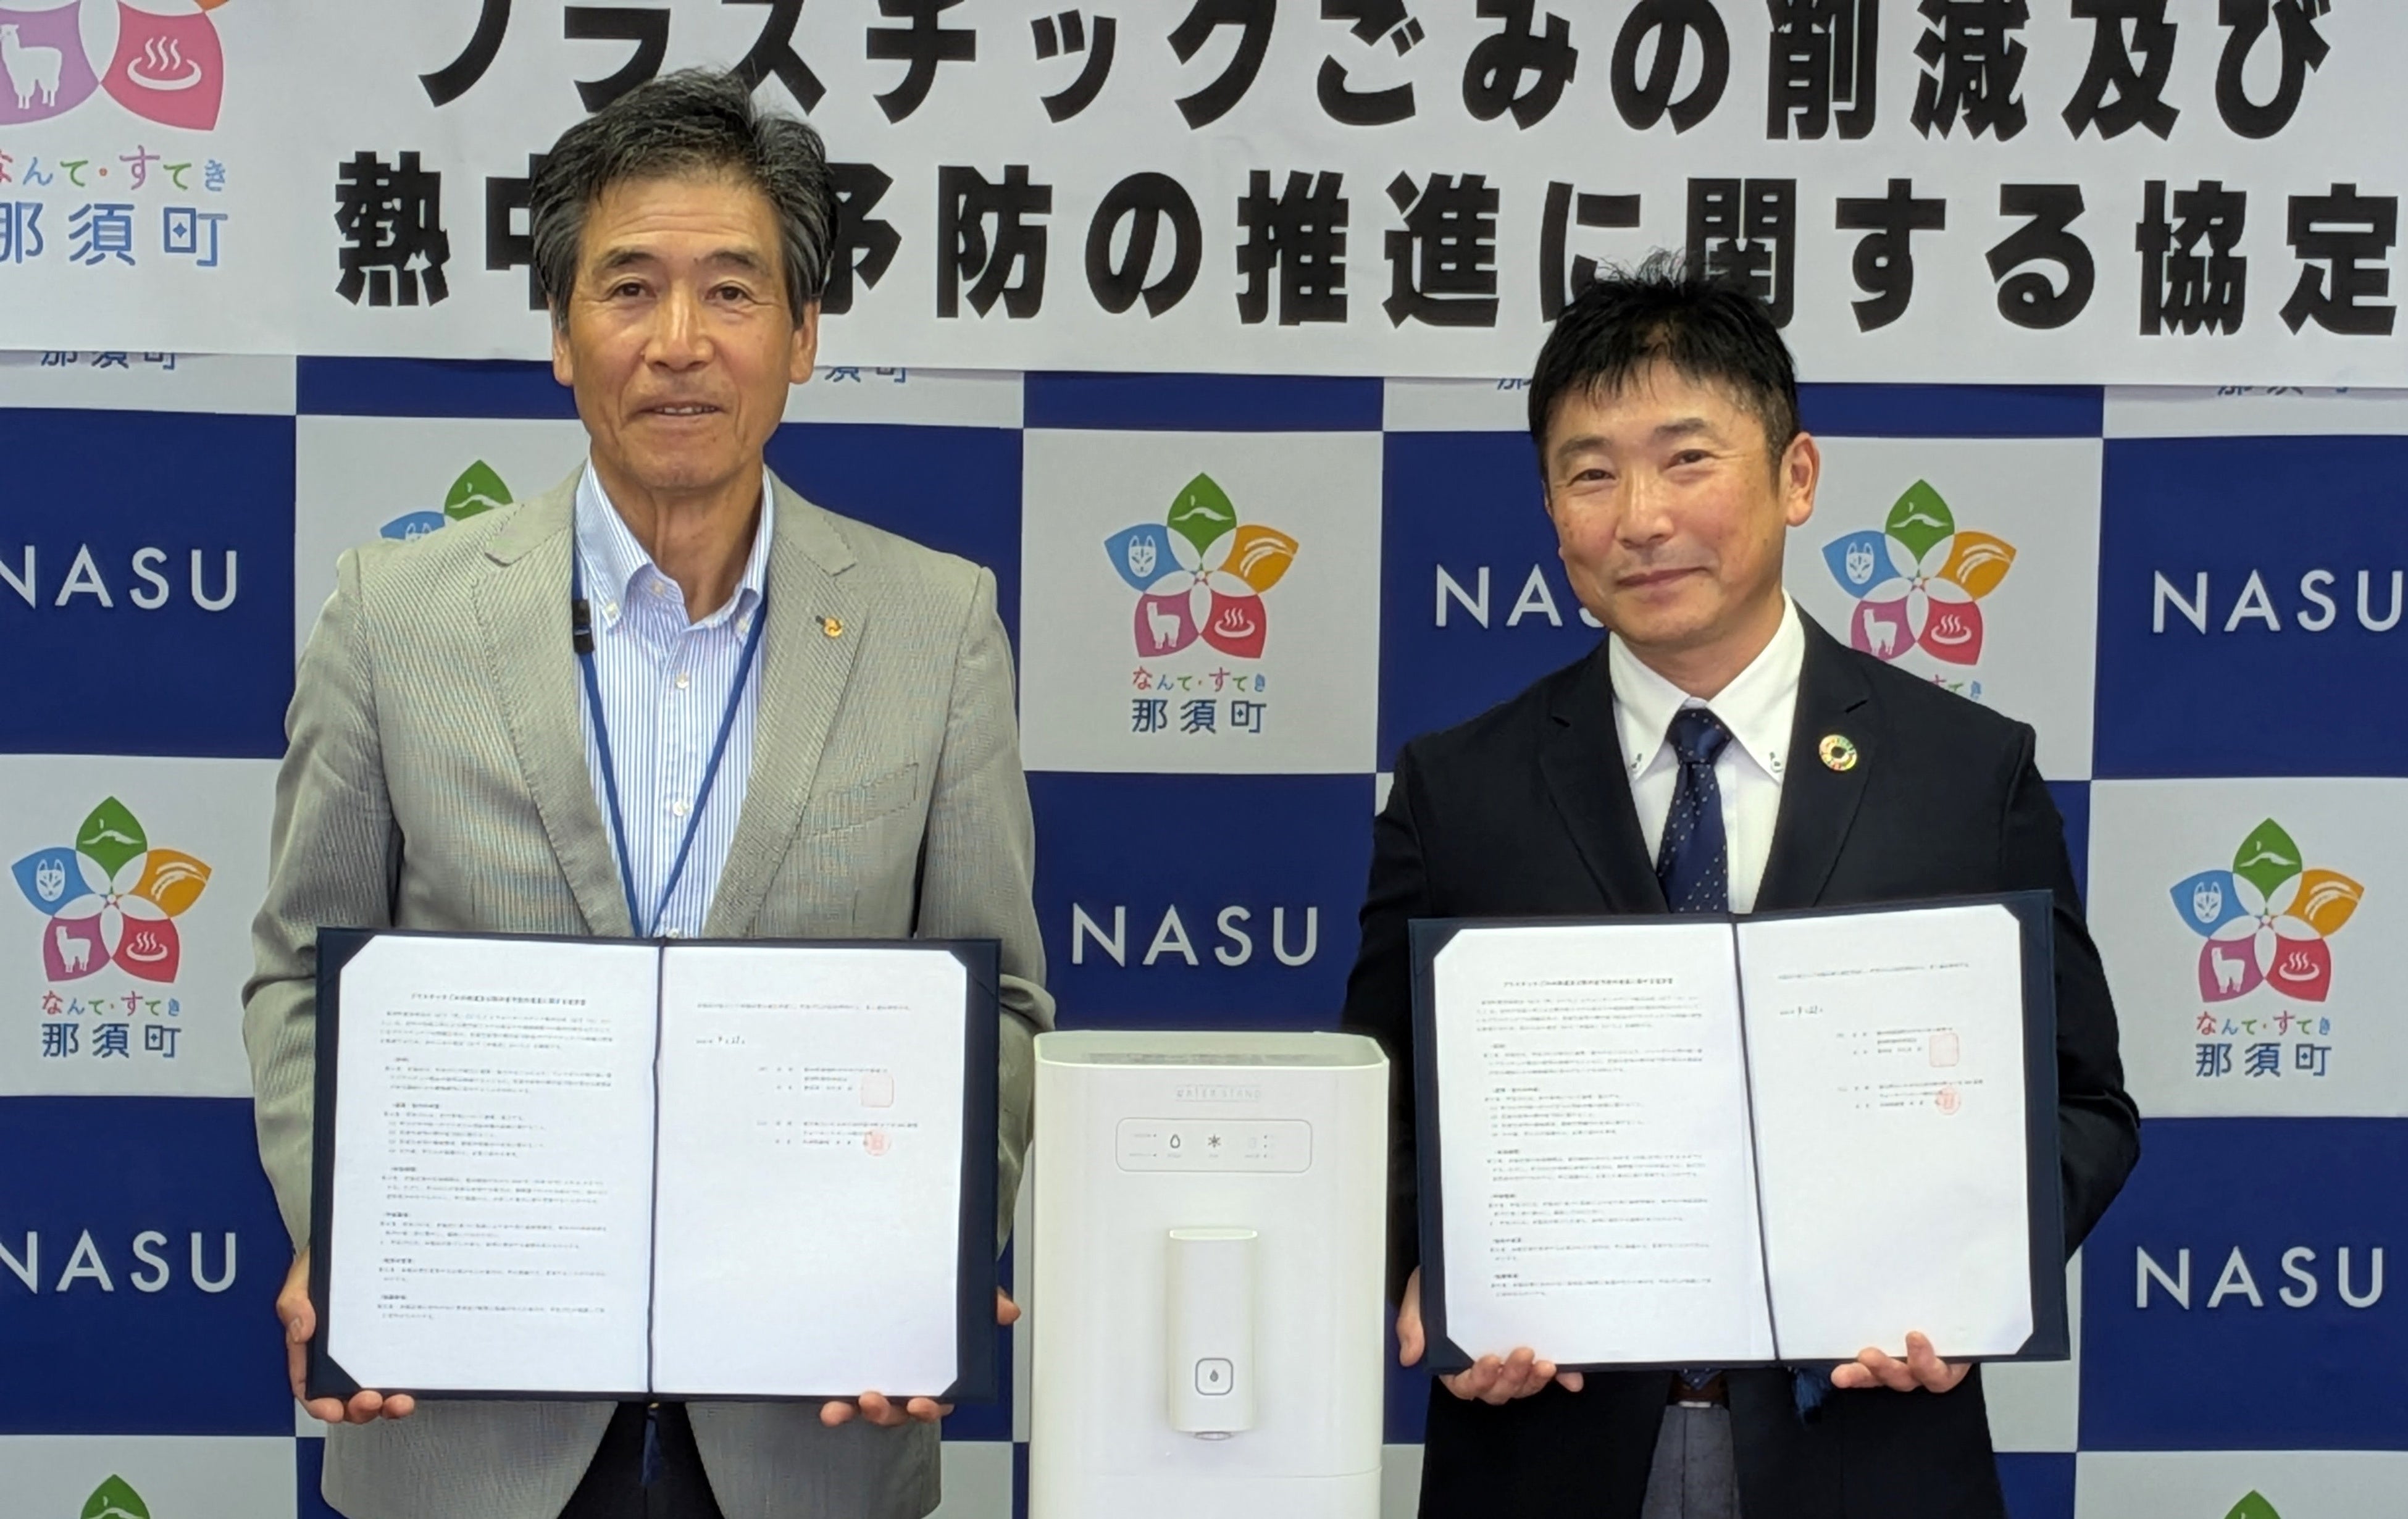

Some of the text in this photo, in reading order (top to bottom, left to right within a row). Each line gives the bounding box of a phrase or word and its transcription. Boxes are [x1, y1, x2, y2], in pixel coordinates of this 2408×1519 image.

[0, 201, 228, 267] 那須町
[335, 151, 2398, 335] 熱中予防の推進に関する協定
[0, 543, 237, 611] NASU
[1436, 563, 1605, 629] NA
[2152, 569, 2403, 635] NASU
[1132, 666, 1266, 692] なんて・すてき
[1132, 699, 1267, 734] 那須町
[1072, 902, 1318, 968] NASU
[42, 990, 180, 1016] なんて・すてき
[2196, 1010, 2331, 1036] なんて・すてき
[41, 1023, 182, 1058] 那須町
[2196, 1042, 2332, 1077] 那須町
[0, 1229, 236, 1294] NASU
[2136, 1245, 2383, 1310] NASU
